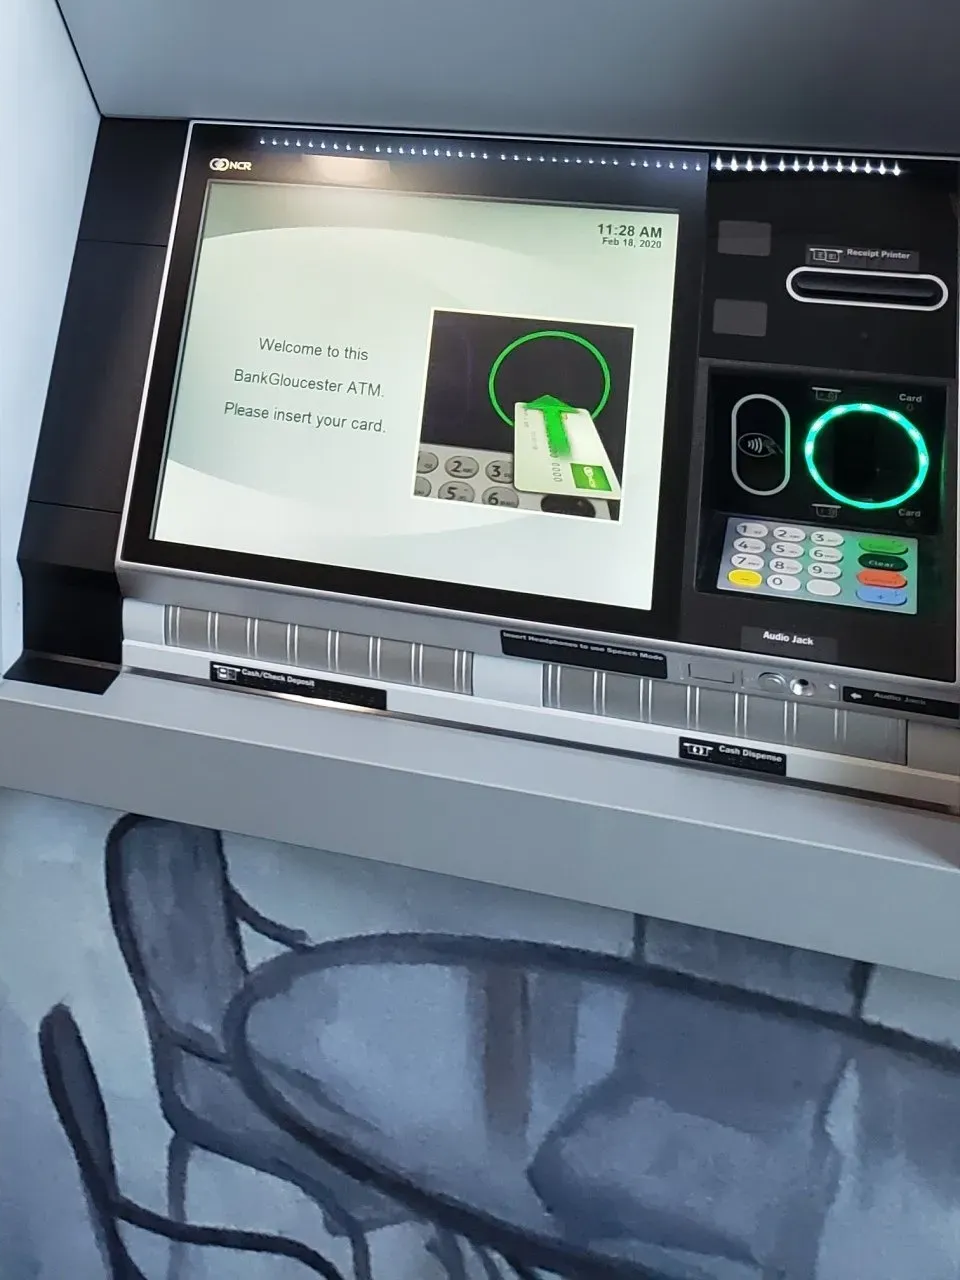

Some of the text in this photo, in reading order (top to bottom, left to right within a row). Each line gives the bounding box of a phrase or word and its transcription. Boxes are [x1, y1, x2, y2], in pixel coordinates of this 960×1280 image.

[229, 161, 252, 171] NCR
[597, 223, 662, 238] 11:28 AM
[602, 237, 662, 248] Feb 18, 2020
[846, 248, 910, 260] Receipt Printer
[259, 337, 369, 361] Welcome to this
[233, 368, 384, 398] BankGloucester ATM.
[899, 393, 923, 403] Card
[224, 401, 386, 433] Please insert your card.
[448, 460, 463, 473] 2
[491, 465, 501, 478] 3
[446, 487, 457, 500] 5
[488, 491, 499, 505] 6
[898, 508, 921, 518] Card
[740, 524, 747, 534] 1
[777, 529, 787, 538] 2
[815, 533, 824, 542] 3
[738, 540, 748, 549] 4
[776, 545, 785, 553] 5
[814, 550, 823, 558] 6
[737, 556, 747, 565] 7
[774, 561, 785, 570] 8
[868, 560, 895, 568] Clear
[812, 566, 822, 574] 9
[763, 630, 814, 646] Audio Jack
[528, 635, 579, 649] Headphones
[606, 647, 638, 658] Speech
[640, 652, 664, 661] Mode
[241, 668, 315, 688] Cash/Check Deposit
[873, 691, 926, 706] Audio Jack
[718, 744, 783, 763] Cash Dispense
